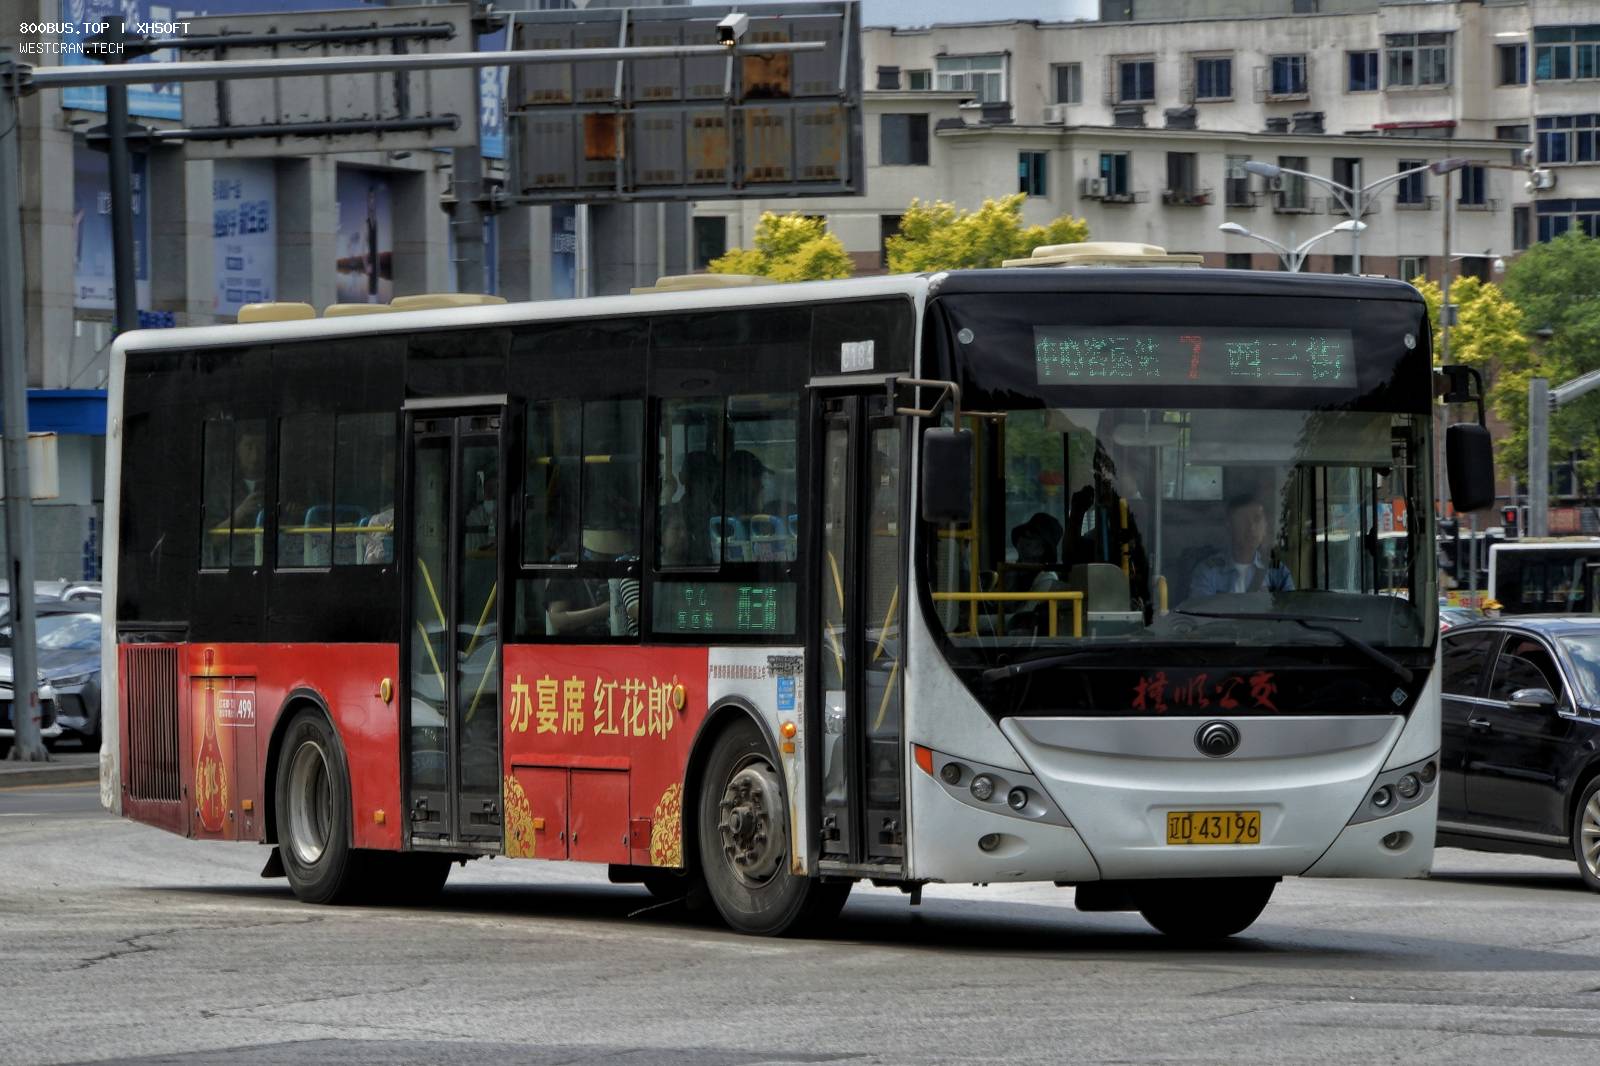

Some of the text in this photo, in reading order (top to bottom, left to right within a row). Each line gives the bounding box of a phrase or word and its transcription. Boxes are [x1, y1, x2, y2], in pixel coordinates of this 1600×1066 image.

[1178, 335, 1201, 379] 7
[509, 674, 674, 741] 办宴席 红花郎
[1168, 815, 1259, 840] 辽D·43196
